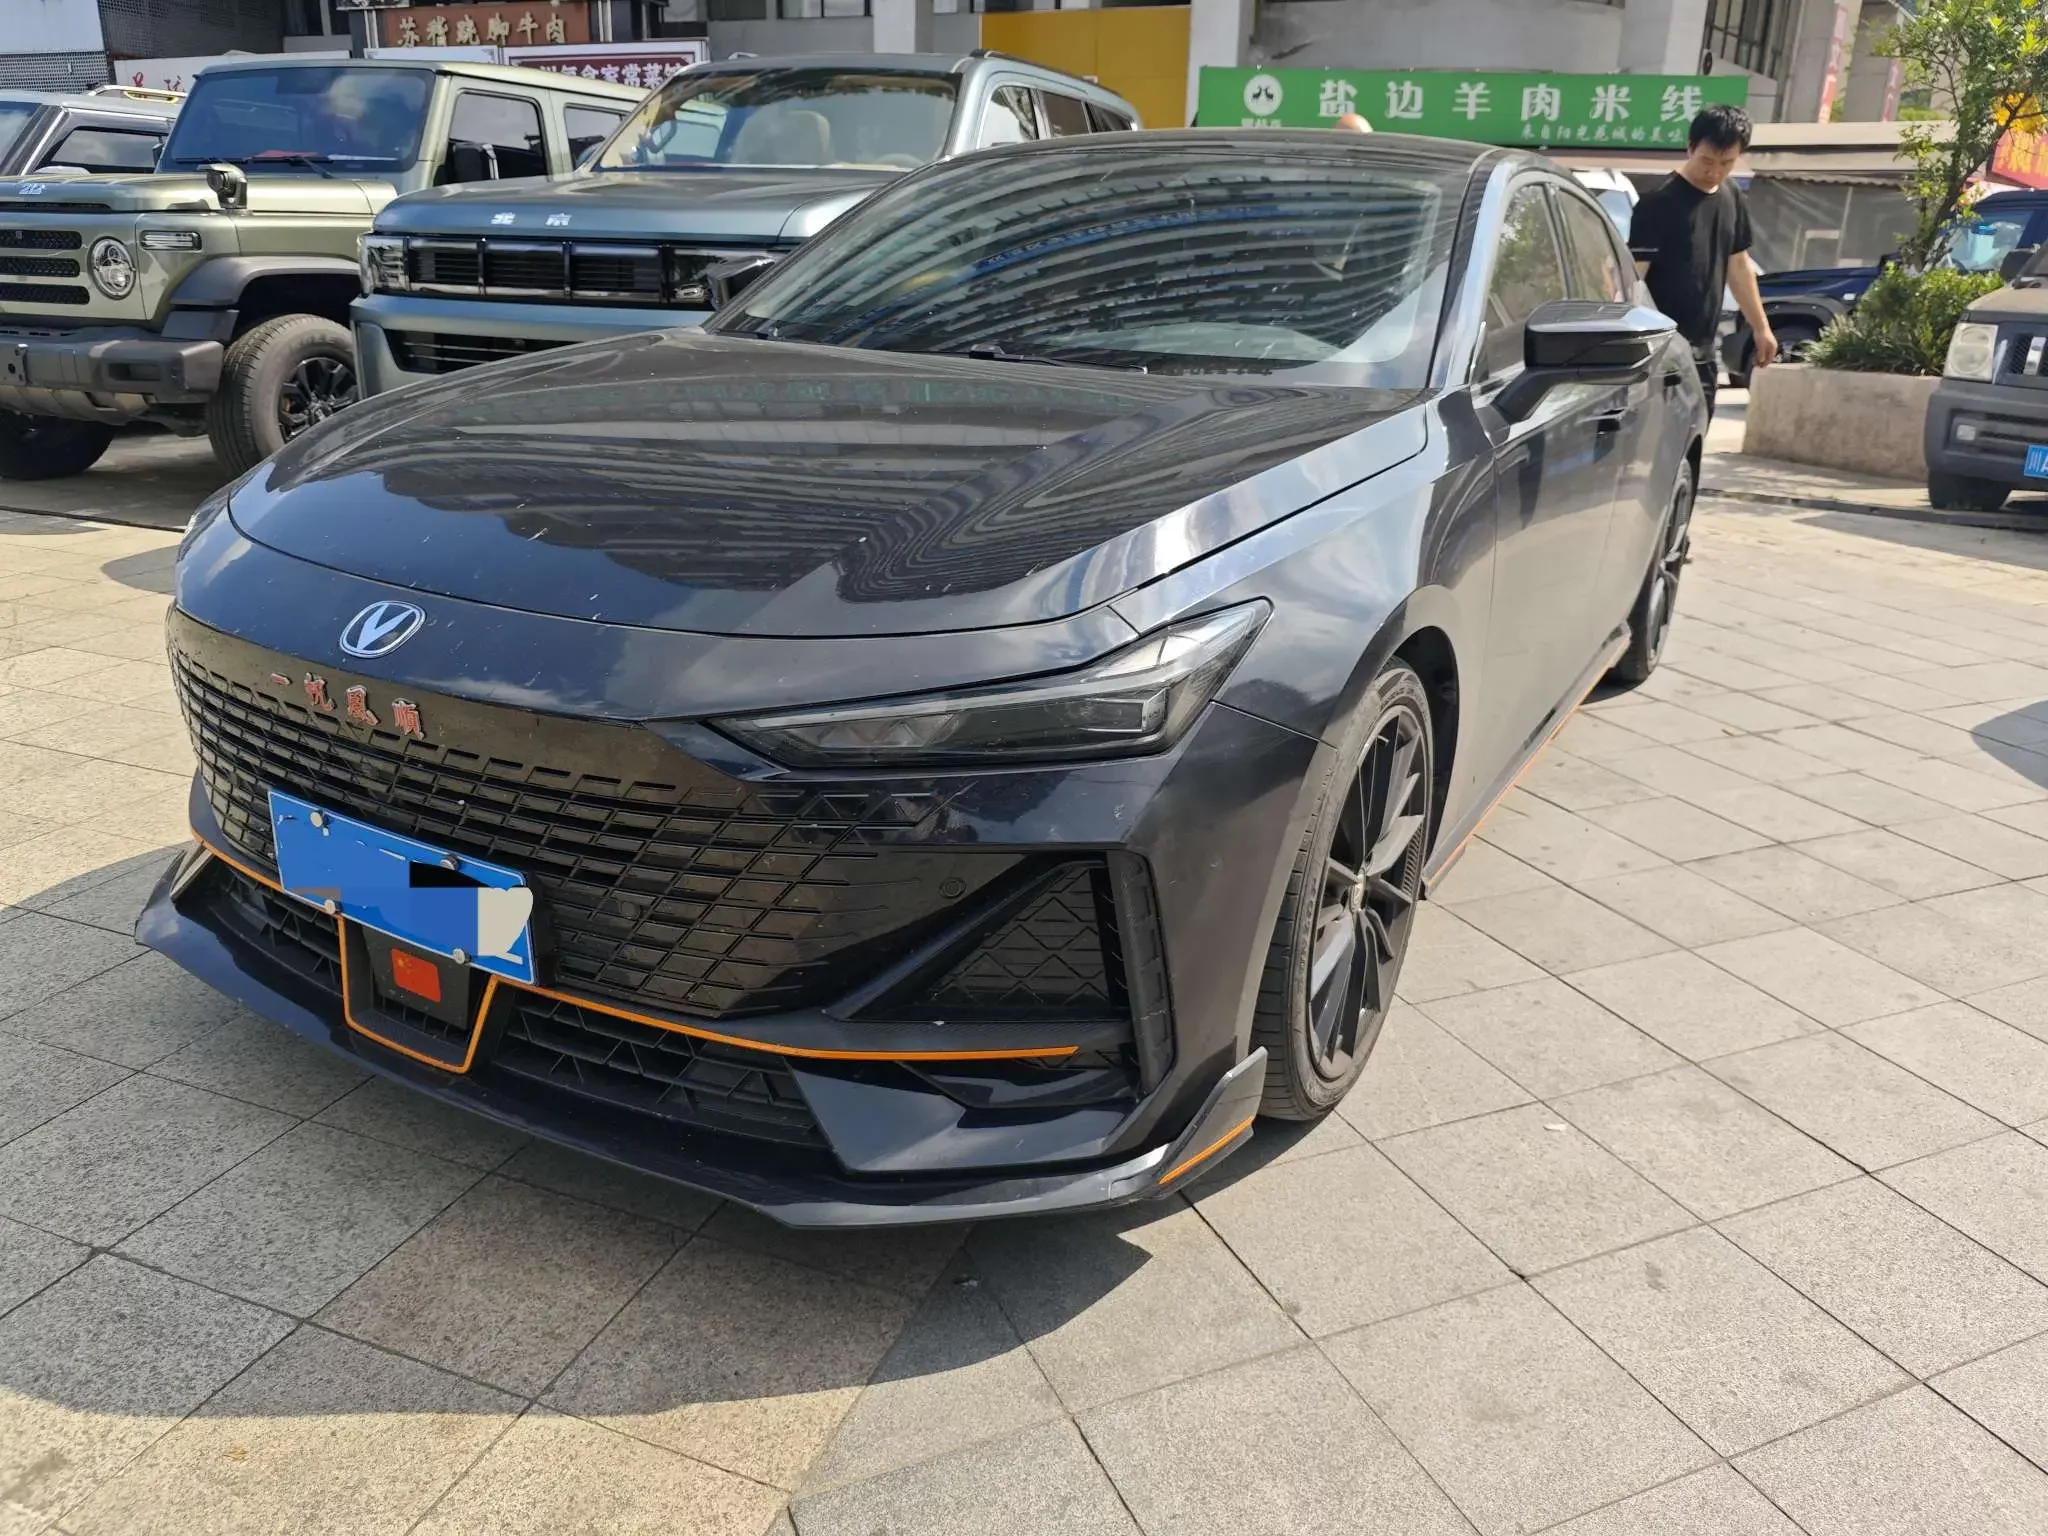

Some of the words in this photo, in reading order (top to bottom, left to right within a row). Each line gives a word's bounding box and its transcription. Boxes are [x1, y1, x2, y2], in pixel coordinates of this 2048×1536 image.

[1318, 79, 1702, 123] 盐边羊肉米线
[490, 211, 572, 227] 北京
